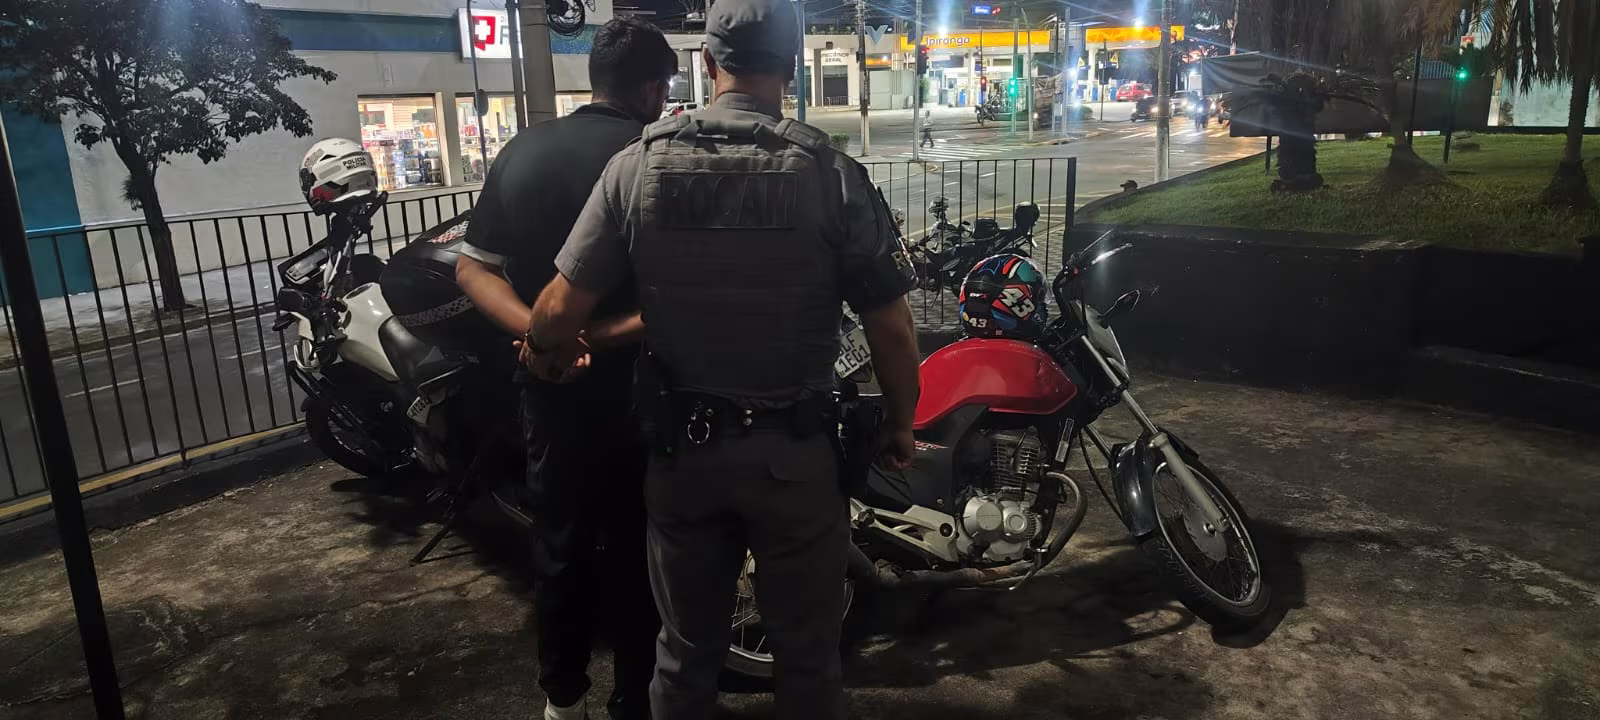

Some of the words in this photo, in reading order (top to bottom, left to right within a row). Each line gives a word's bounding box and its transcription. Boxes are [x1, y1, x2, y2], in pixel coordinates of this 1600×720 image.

[926, 36, 970, 46] Ipiranga
[346, 161, 366, 170] MILITAR
[662, 175, 797, 226] ROCAM
[1000, 288, 1036, 318] 43
[969, 317, 988, 328] 43
